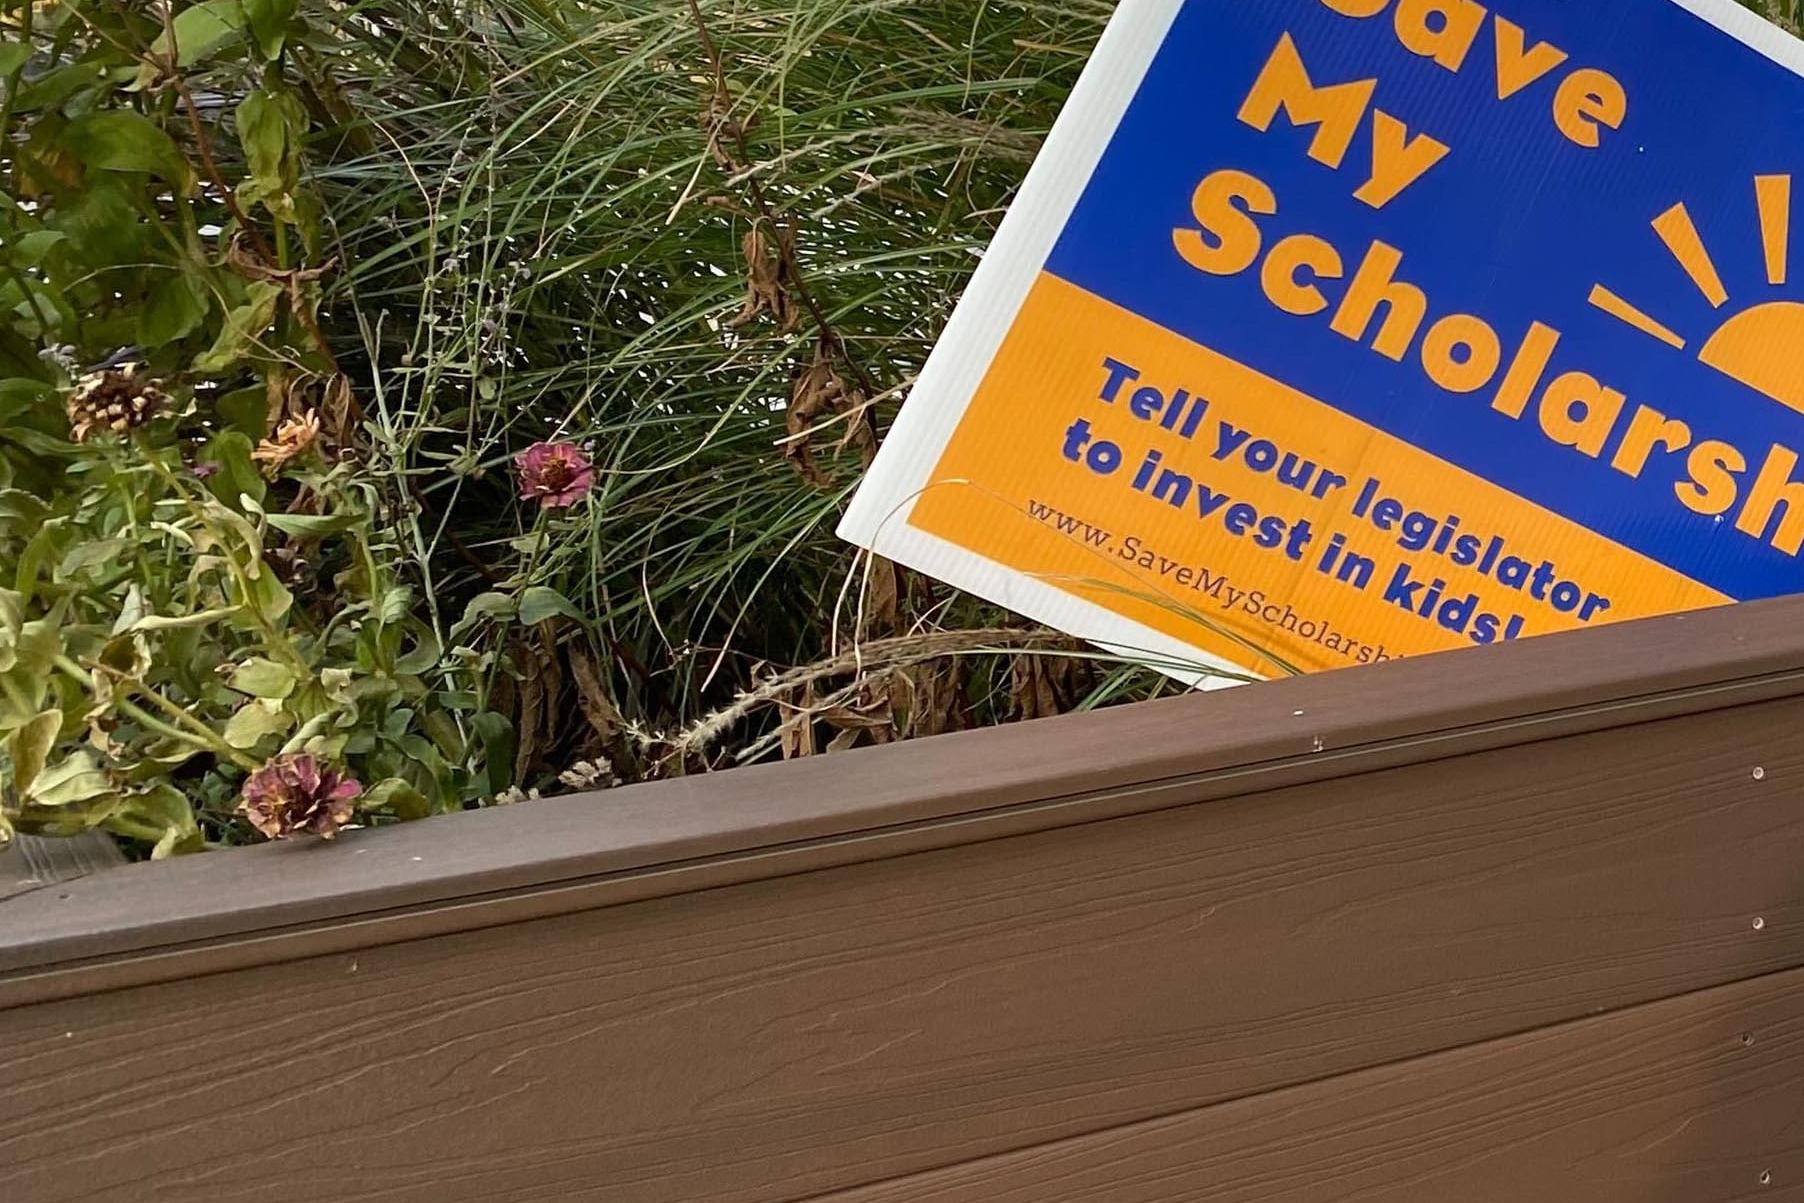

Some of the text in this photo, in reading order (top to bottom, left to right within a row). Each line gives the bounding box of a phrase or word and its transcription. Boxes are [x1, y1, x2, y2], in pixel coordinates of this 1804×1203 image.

[1237, 30, 1451, 209] My
[1026, 499, 1404, 663] www.SaveMyScholarsh
[1061, 417, 1526, 645] to invest in kids!
[1096, 356, 1611, 622] Tell your legislator
